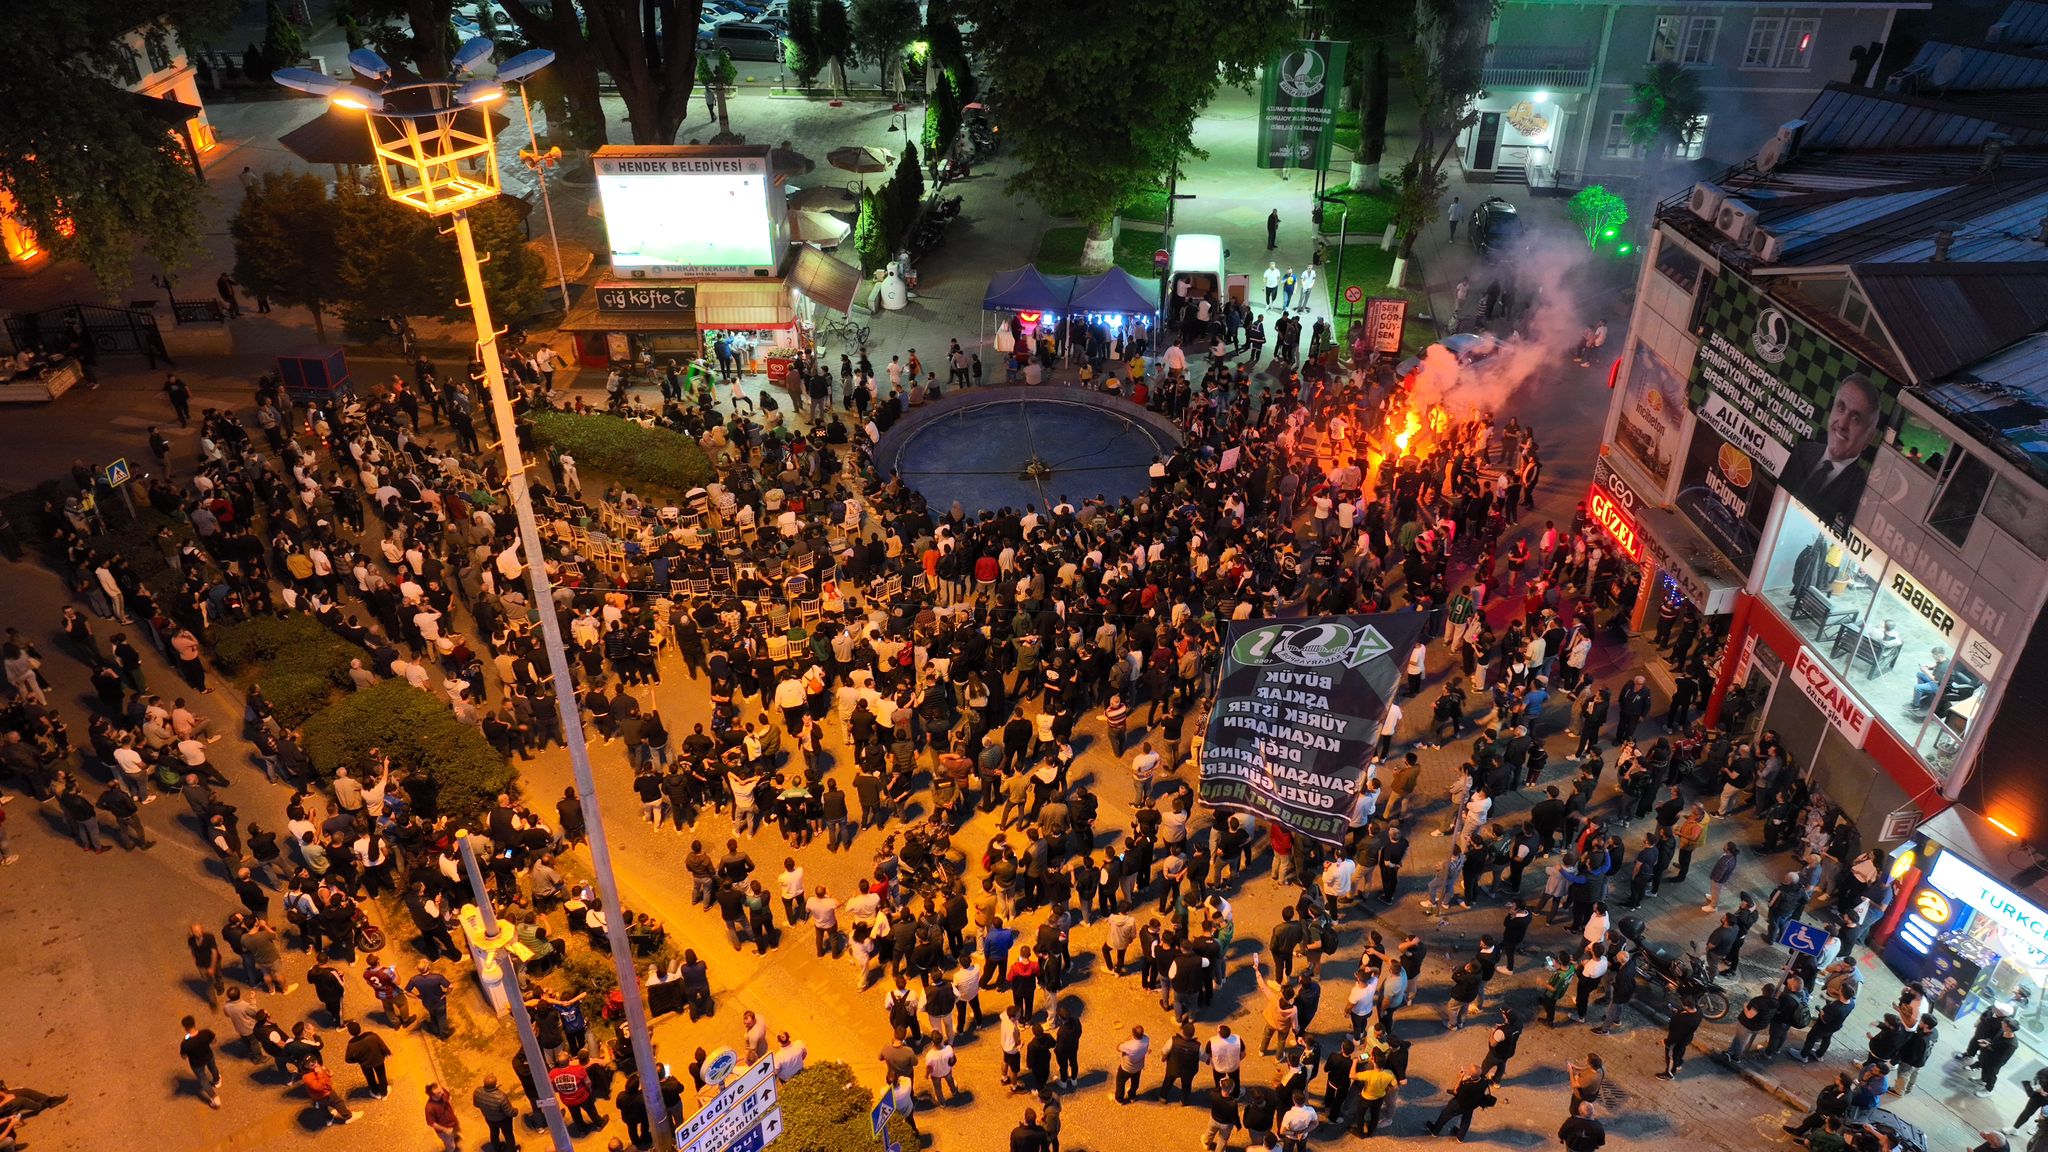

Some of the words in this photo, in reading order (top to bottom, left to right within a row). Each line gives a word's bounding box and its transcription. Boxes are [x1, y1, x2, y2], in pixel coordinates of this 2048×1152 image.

[618, 161, 667, 173] HENDEK
[672, 158, 742, 173] BELEDİYESİ
[604, 290, 626, 309] çiğ
[630, 289, 671, 309] köfte
[1381, 304, 1399, 312] SEN
[1377, 331, 1395, 339] SEN
[1701, 345, 1764, 404] ŞAMPİYONLUK
[1767, 393, 1813, 437] YOLUNDA
[1703, 367, 1755, 416] BAŞARILAR
[1709, 332, 1815, 419] SAKARYASPOR'UMUZA
[1635, 399, 1666, 437] incibeton
[1716, 406, 1740, 429] ALİ
[1739, 420, 1767, 450] İNCİ
[1718, 424, 1743, 447] SAKARYA
[1705, 466, 1747, 518] incigrup
[1591, 494, 1637, 556] GÜZEL
[1871, 516, 2008, 638] DERSHANELERİ
[1455, 603, 1464, 615] 9
[1795, 653, 1865, 733] ECZANE
[1805, 683, 1828, 716] ÖZLEM
[1827, 709, 1843, 729] ŞİFA
[1892, 818, 1910, 836] E
[370, 976, 382, 987] 3
[680, 1084, 745, 1142] Belediye
